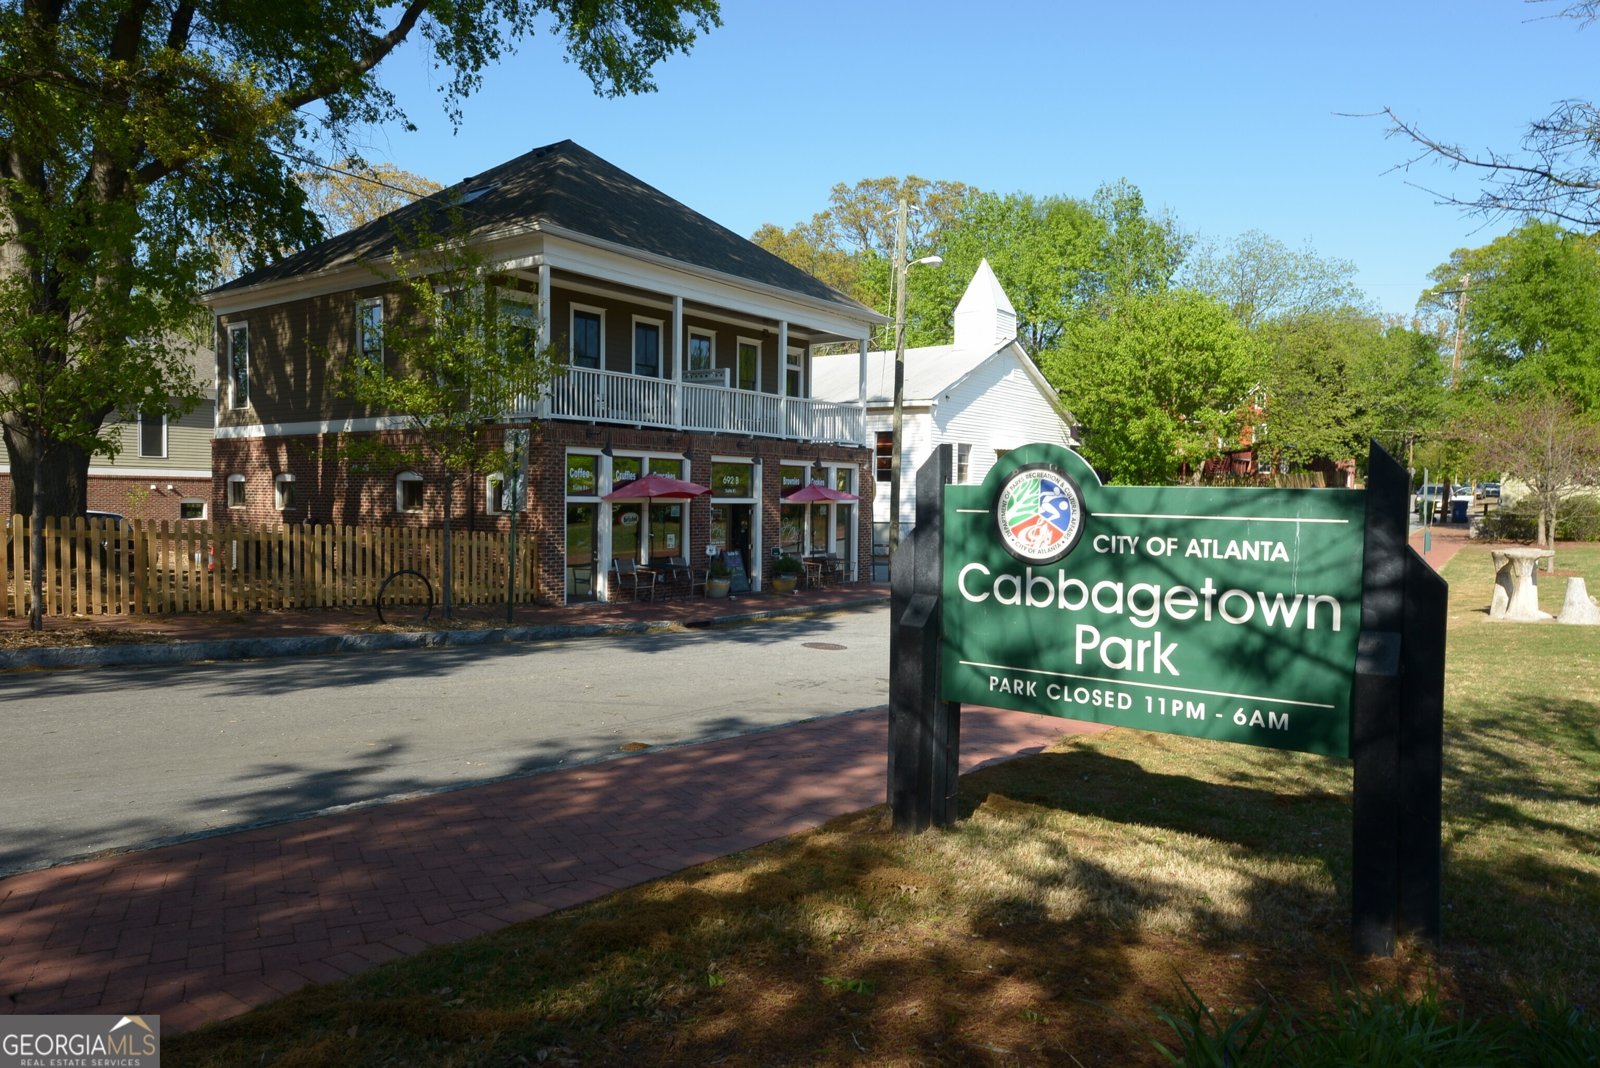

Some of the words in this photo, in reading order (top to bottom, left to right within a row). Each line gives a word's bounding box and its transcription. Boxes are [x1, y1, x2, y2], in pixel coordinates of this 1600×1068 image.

[569, 467, 590, 479] Coffee
[722, 475, 734, 485] 692
[782, 476, 800, 486] Brownies
[1025, 472, 1060, 485] RECREATION
[1009, 477, 1025, 490] PARKS
[1004, 491, 1011, 499] OF
[1064, 488, 1077, 516] CULTURAL
[1001, 500, 1011, 538] DEPARTMENT
[1063, 517, 1077, 540] AFFAIRS
[1015, 541, 1026, 551] CITY
[1038, 543, 1062, 555] ATLANTA
[1093, 534, 1140, 555] CITY
[1146, 536, 1178, 558] OF
[1184, 538, 1289, 563] ATLANTA
[958, 562, 1342, 632] Cabbagetown
[1075, 624, 1180, 676] Park
[989, 675, 1037, 698] PARK
[1046, 684, 1132, 710] CLOSED
[1144, 696, 1206, 721] 11PM
[1233, 707, 1289, 731] 6AM
